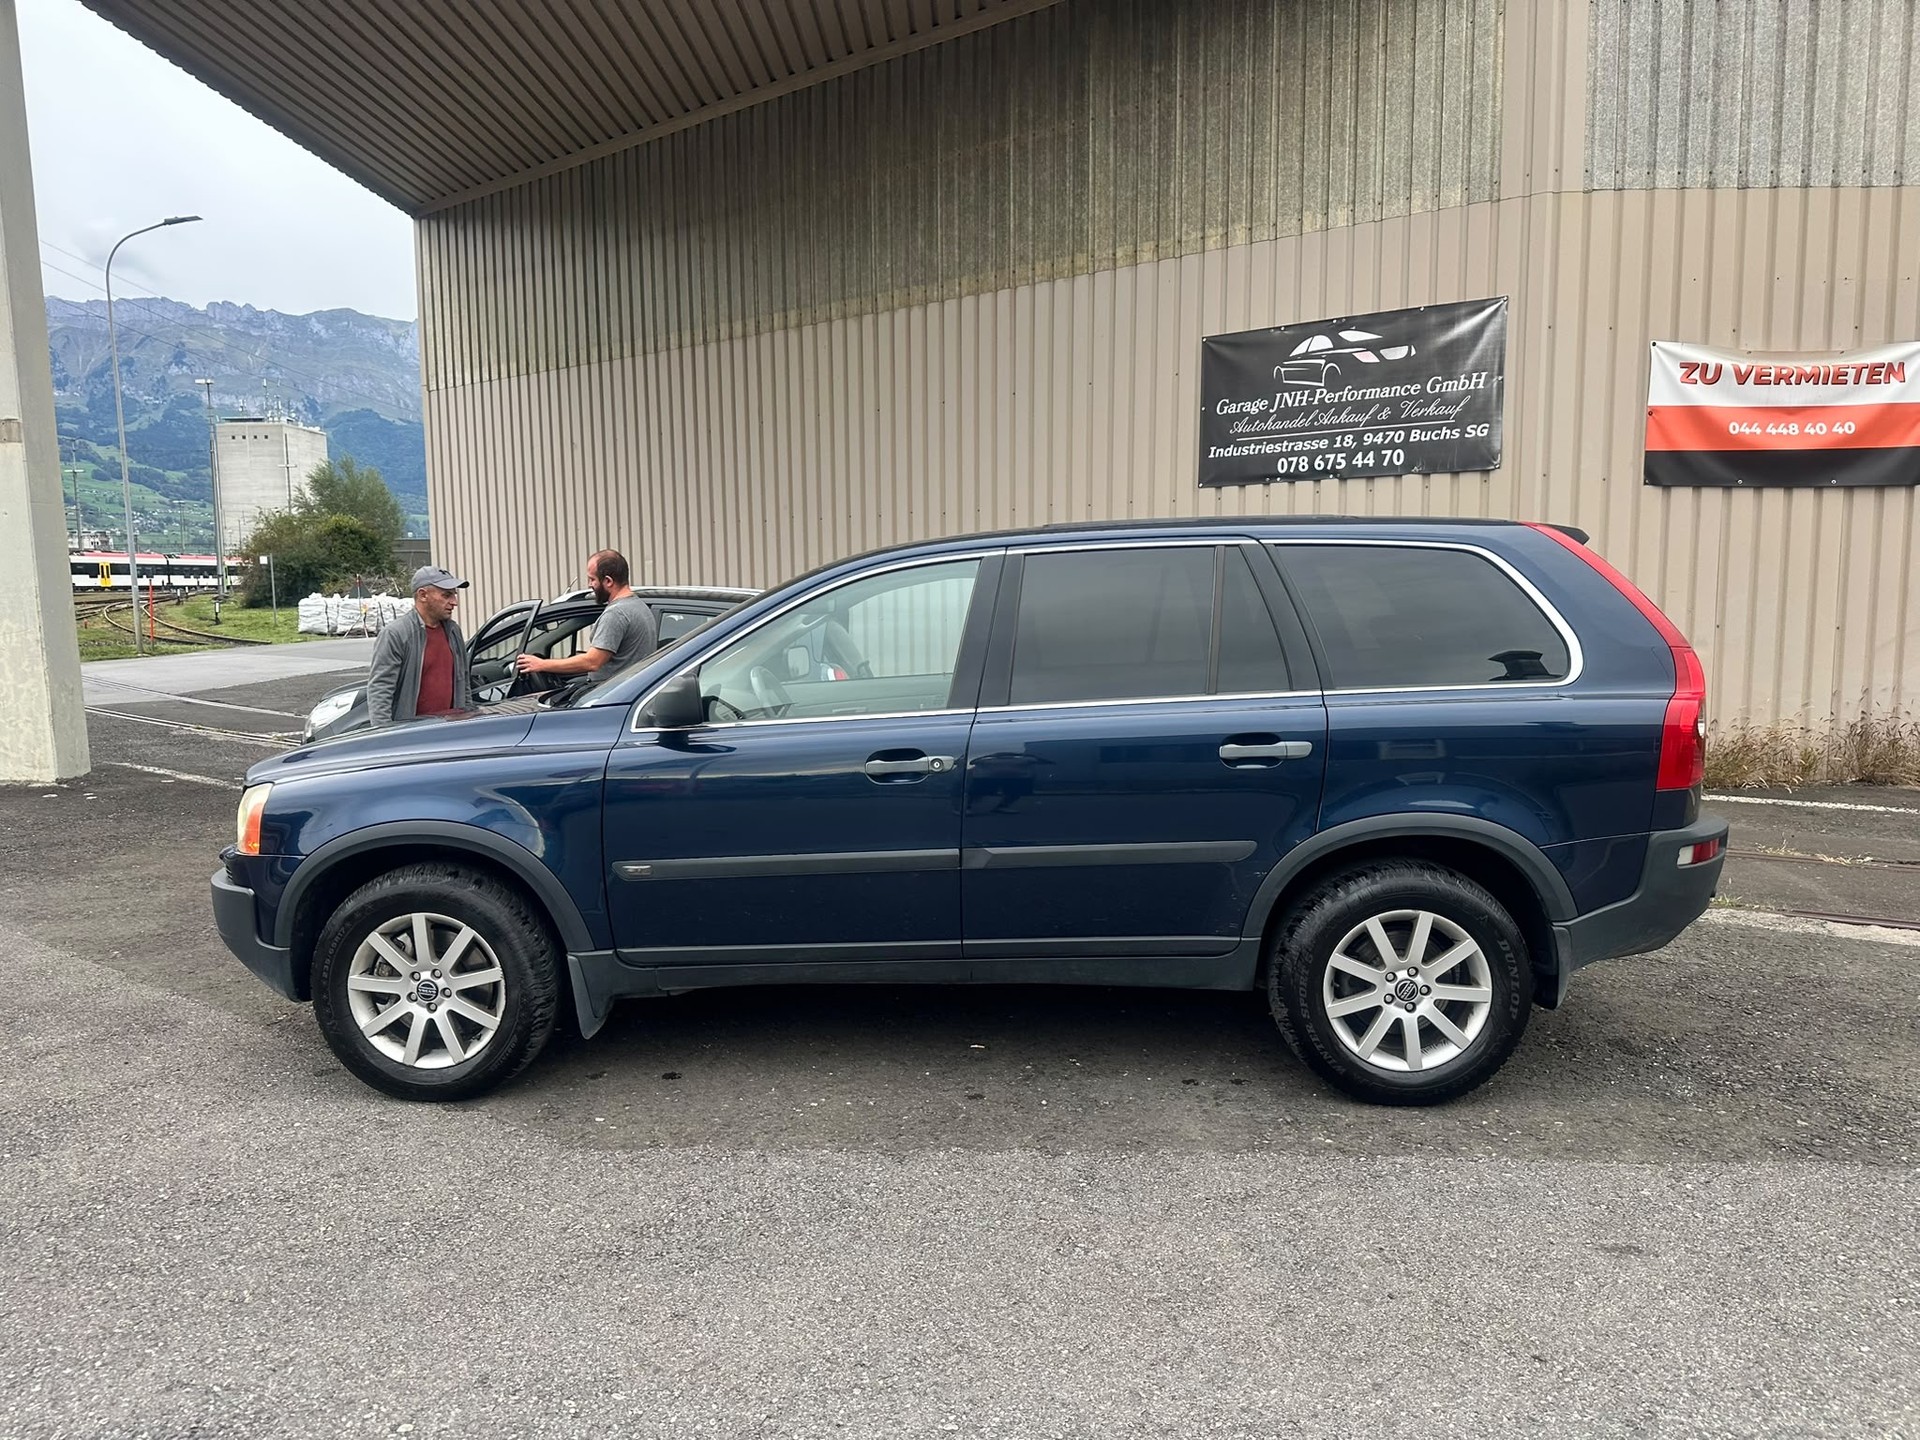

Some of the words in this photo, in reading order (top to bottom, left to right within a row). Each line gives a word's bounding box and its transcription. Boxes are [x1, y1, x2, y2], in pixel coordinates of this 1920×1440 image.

[1216, 398, 1269, 415] Garage
[1269, 383, 1421, 413] JNH-Performance
[1426, 371, 1488, 394] GmbH
[1679, 361, 1723, 385] ZU
[1731, 361, 1906, 386] VERMIETEN
[1229, 409, 1319, 434] Autohandel
[1314, 403, 1380, 427] Ankauf
[1377, 406, 1391, 420] &
[1400, 395, 1471, 420] Verkauf
[1728, 421, 1762, 435] 044
[1765, 422, 1800, 435] 448
[1804, 422, 1827, 435] 40
[1832, 421, 1856, 435] 40
[1208, 438, 1329, 458] Industriestrasse
[1333, 434, 1357, 449] 18,
[1363, 430, 1405, 446] 9470
[1409, 427, 1461, 442] Buchs
[1464, 423, 1490, 438] SG
[1277, 455, 1309, 474] 078
[1314, 453, 1347, 471] 675
[1352, 450, 1375, 468] 44
[1381, 448, 1405, 467] 70
[1297, 963, 1311, 1020] SPORT
[1497, 938, 1521, 1020] DUNLOP
[1305, 1022, 1347, 1075] WINTER
